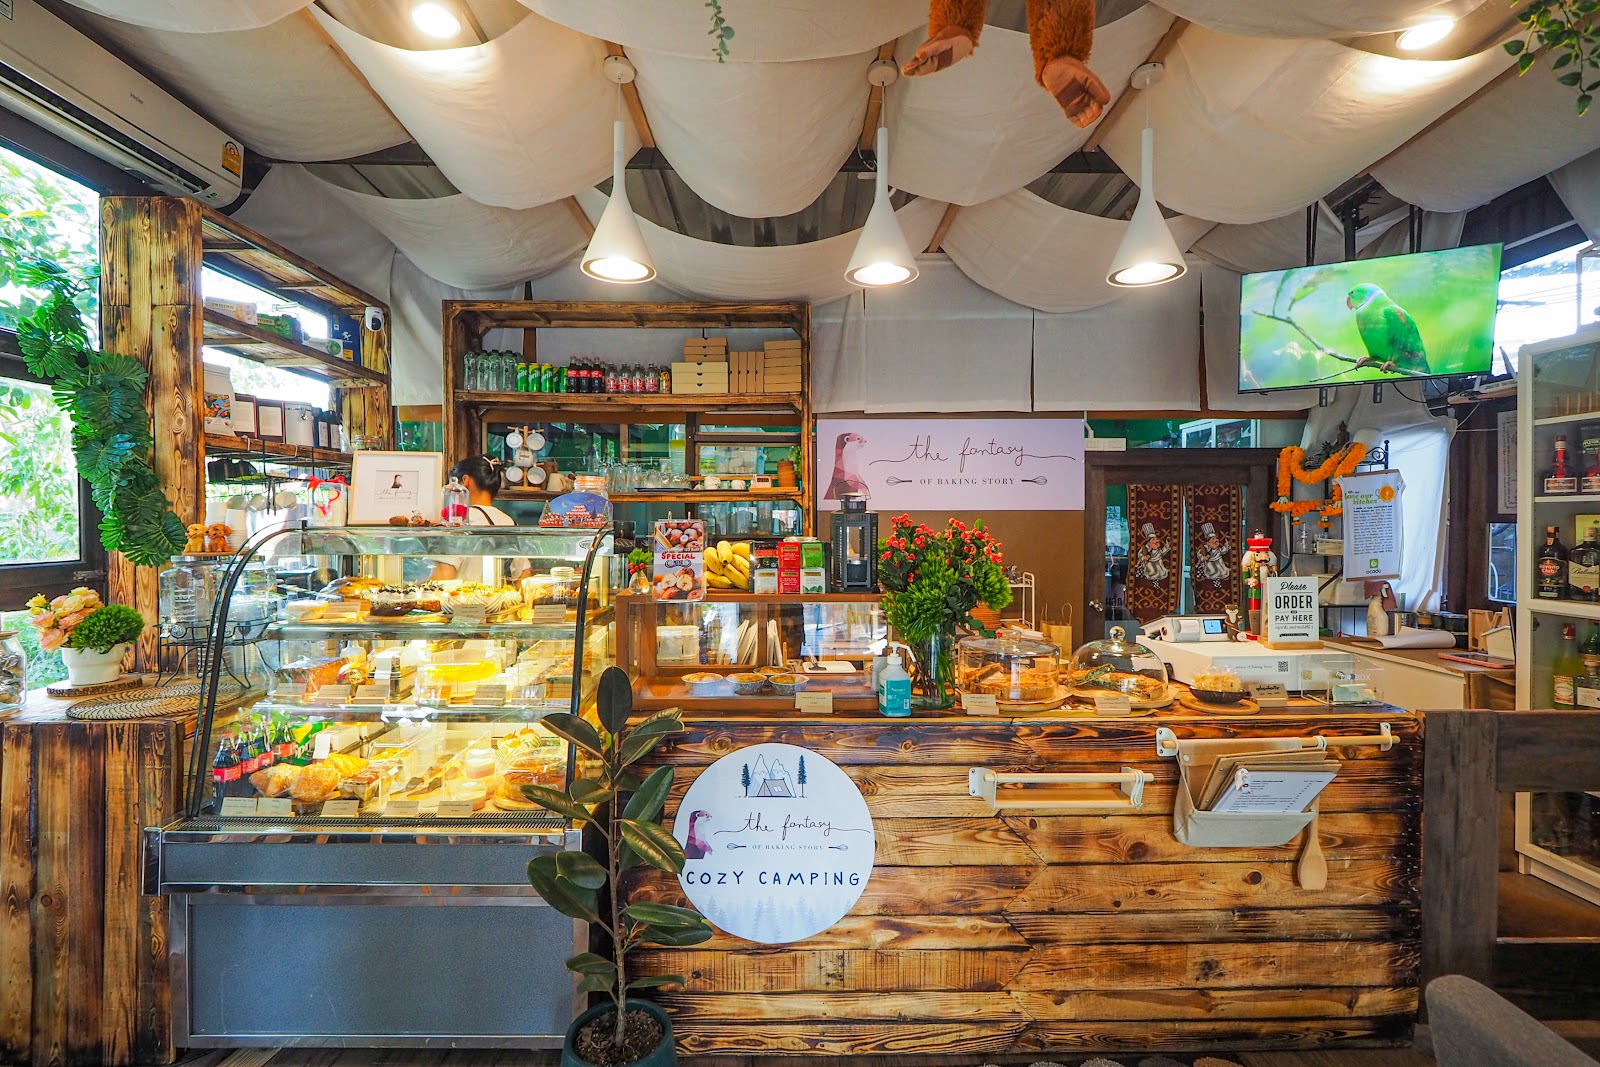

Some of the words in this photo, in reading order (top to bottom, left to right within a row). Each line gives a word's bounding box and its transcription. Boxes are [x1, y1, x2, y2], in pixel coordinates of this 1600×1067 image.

[897, 434, 949, 462] the
[958, 436, 1040, 474] fantasy
[919, 477, 934, 486] OF
[937, 477, 977, 486] BAKING
[982, 476, 1015, 486] STORY
[661, 551, 696, 560] SPECIAL
[1280, 581, 1308, 591] Please
[1275, 595, 1313, 609] ORDER
[1275, 614, 1290, 622] PAY
[1292, 614, 1313, 622] HERE
[735, 811, 774, 833] the
[782, 813, 842, 841] fantasy
[686, 871, 744, 885] COZY
[758, 871, 860, 886] CAMPING
